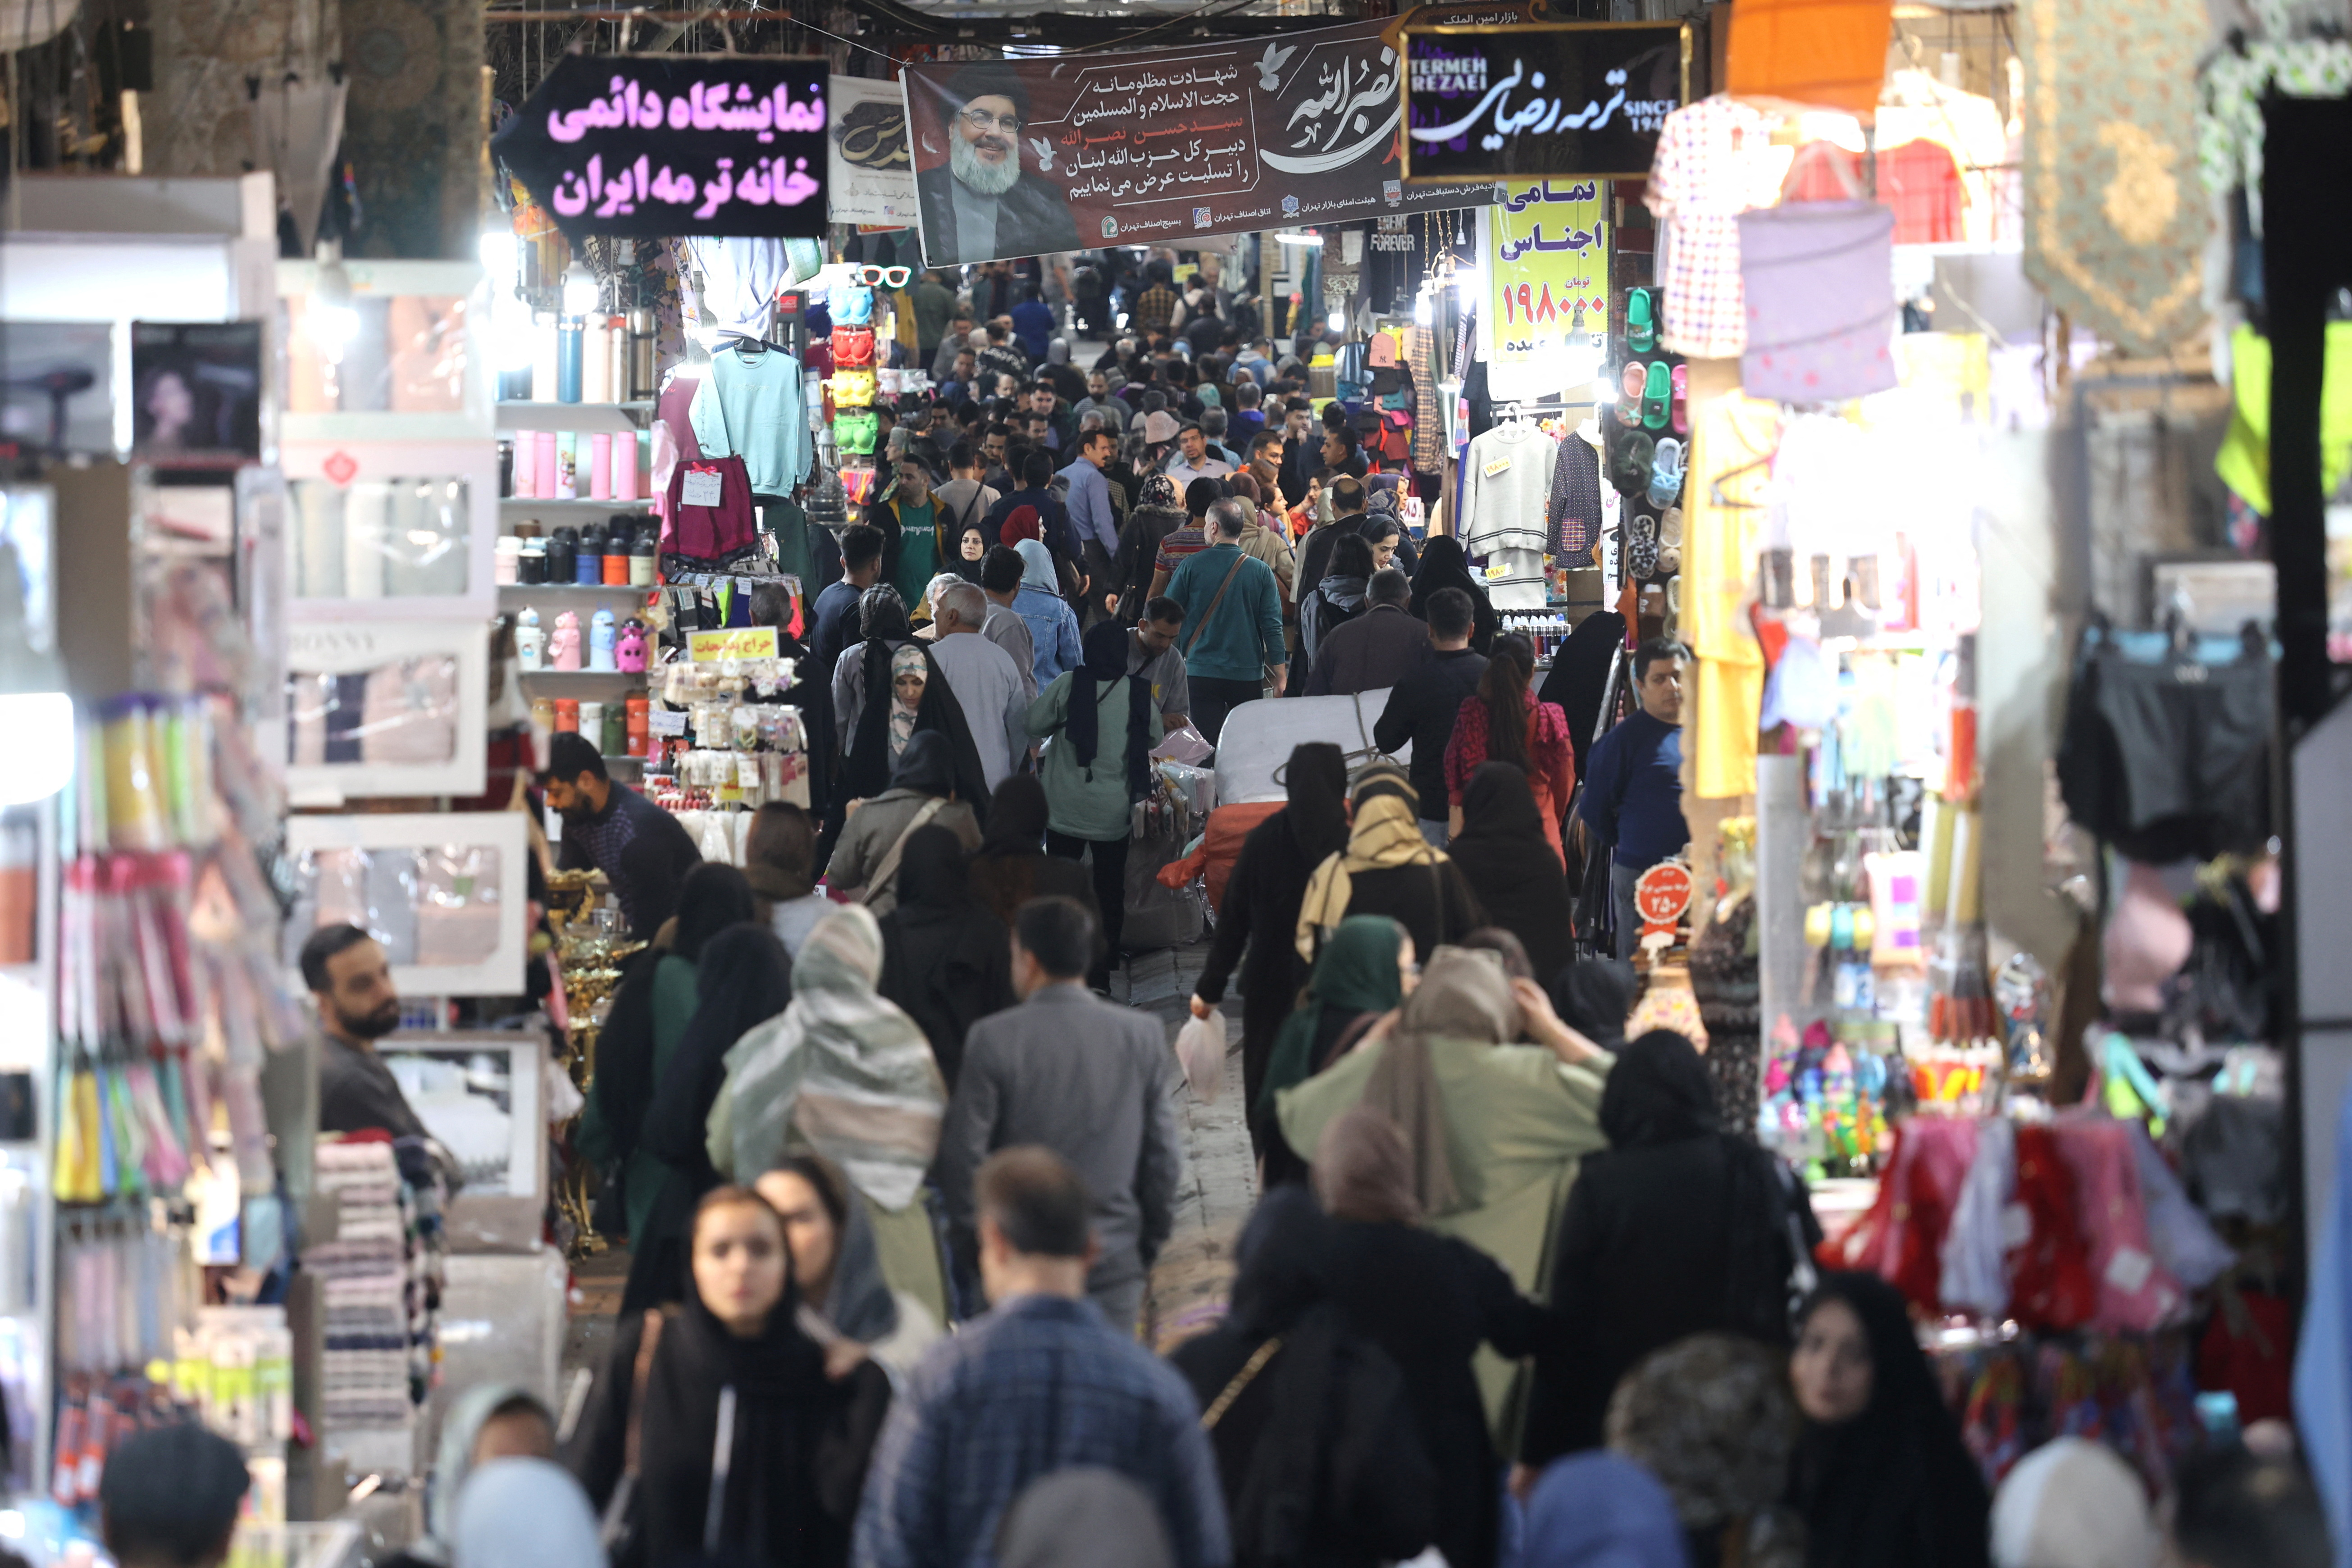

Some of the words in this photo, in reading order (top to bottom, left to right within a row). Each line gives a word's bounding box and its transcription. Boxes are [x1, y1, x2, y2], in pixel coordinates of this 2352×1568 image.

[1443, 14, 1473, 25] الملک
[1476, 13, 1497, 26] امین
[1499, 12, 1518, 24] بازار
[1169, 64, 1238, 86] شهادت
[1409, 58, 1487, 75] TERMEH
[1093, 72, 1167, 95] مظلومانه
[1411, 74, 1487, 92] REZAEI
[1149, 91, 1198, 118] الاسلام
[1200, 91, 1239, 106] حجت
[1410, 58, 1561, 150] رضایی
[1556, 69, 1627, 134] ترمه
[547, 74, 664, 143] دائمی
[668, 80, 826, 143] نمایشگاه
[1073, 97, 1136, 126] المسلمین
[1139, 105, 1146, 119] و
[1190, 117, 1243, 133] سید
[1631, 116, 1663, 132] 194
[1134, 123, 1188, 144] حسن
[1108, 147, 1127, 166] الله
[1130, 148, 1180, 168] حزب
[1184, 138, 1202, 162] کل
[1203, 139, 1246, 161] دبیر
[1066, 150, 1106, 177] لبنان
[1236, 159, 1249, 182] را
[736, 156, 820, 206] خانه
[1135, 171, 1175, 194] عرض
[1178, 163, 1232, 184] تسلیت
[552, 154, 649, 217] ایران
[650, 157, 734, 220] ترمه
[1425, 187, 1459, 197] دستبافت
[1459, 183, 1479, 195] فرش
[1336, 198, 1354, 208] امنای
[1354, 196, 1376, 205] هیئت
[1406, 191, 1425, 200] تهران
[1234, 210, 1257, 219] اصناف
[1257, 208, 1271, 217] اتاق
[1301, 203, 1321, 212] تهران
[1321, 201, 1336, 210] بازار
[1139, 219, 1162, 229] اصناف
[1162, 219, 1181, 229] بسیج
[1214, 213, 1234, 222] تهران
[1120, 223, 1140, 232] تهران
[1370, 234, 1415, 252] FOREVER
[1501, 221, 1602, 261] اجناس
[1565, 276, 1591, 289] تومان
[1502, 282, 1606, 325] ۱۹۸۰۰۰
[743, 637, 771, 652] حراج
